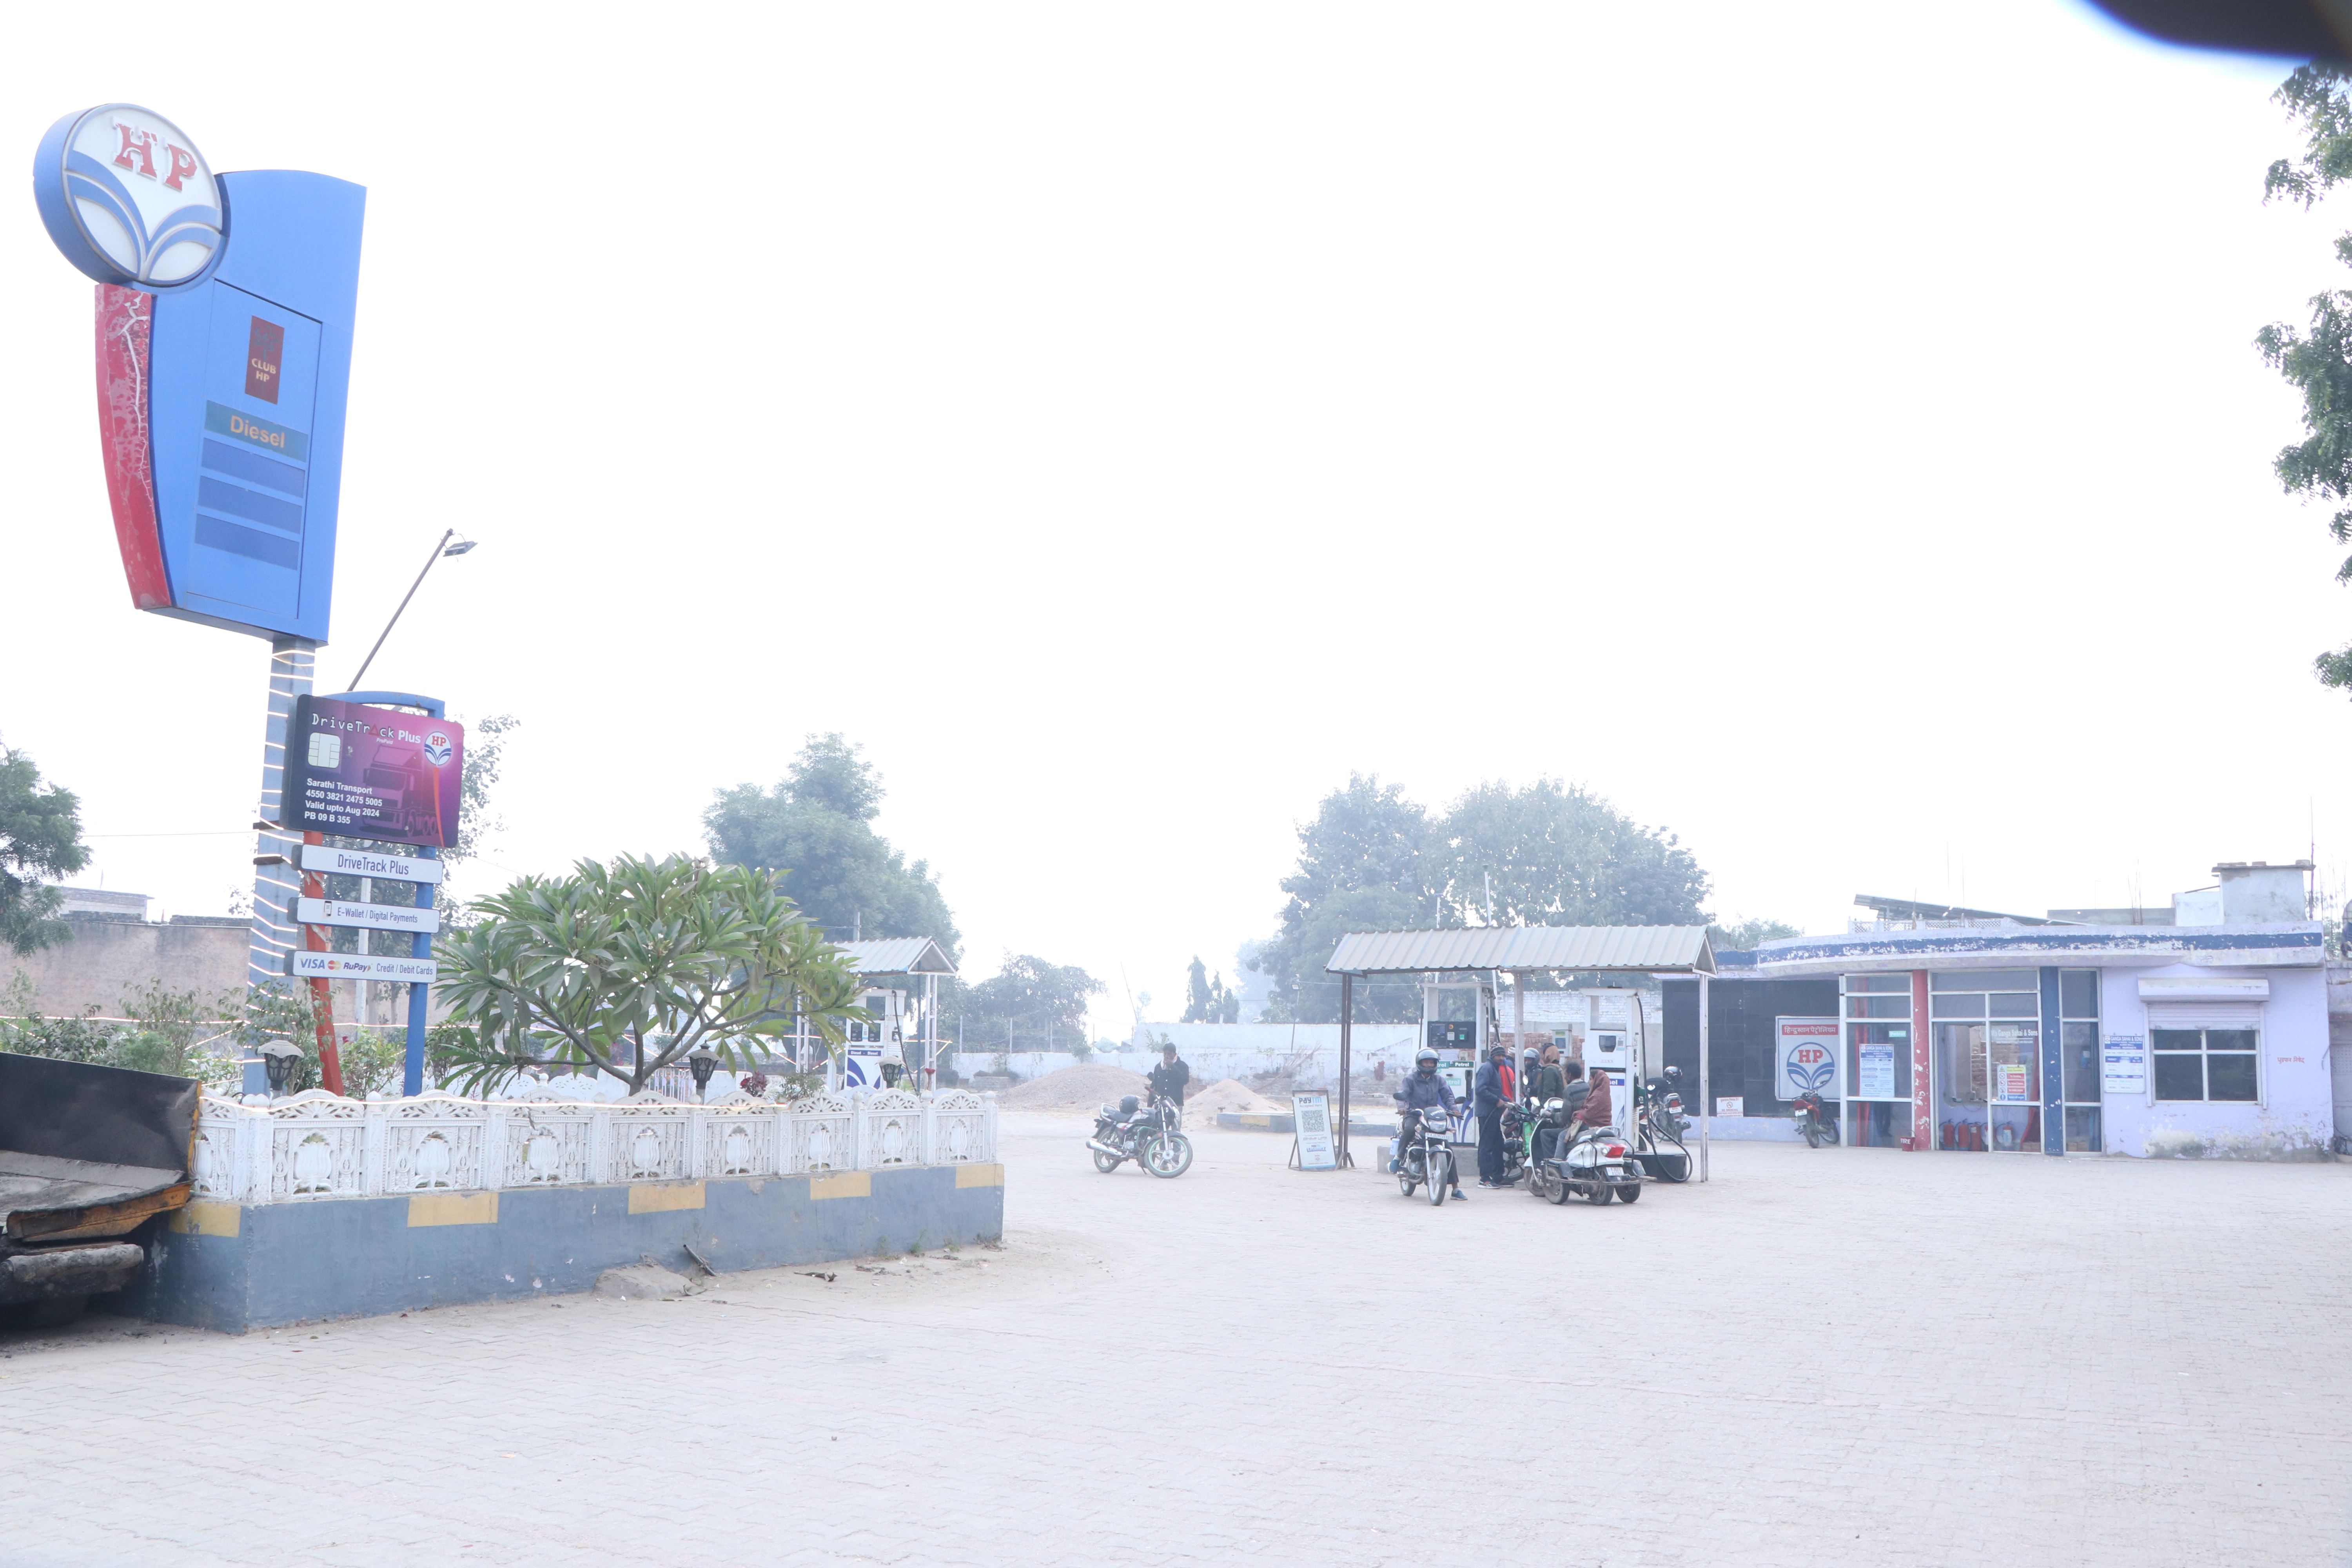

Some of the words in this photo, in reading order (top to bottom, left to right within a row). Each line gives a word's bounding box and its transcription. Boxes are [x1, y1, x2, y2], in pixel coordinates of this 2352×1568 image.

[112, 116, 198, 192] HP
[251, 358, 276, 374] CLUB
[256, 370, 270, 383] HP
[230, 416, 285, 448] Diesel
[398, 730, 421, 744] Plus
[432, 735, 446, 747] HP
[307, 778, 334, 789] Sarathi
[337, 782, 372, 795] Transport
[306, 789, 324, 799] 4550
[327, 792, 344, 801] 3821
[346, 795, 364, 804] 2475
[365, 797, 383, 807] 5005
[305, 800, 325, 810] Valid
[327, 804, 344, 815] upto
[345, 806, 360, 816] Aug
[362, 808, 380, 817] 2024
[305, 811, 316, 820] PB
[318, 813, 327, 822] 09
[337, 815, 350, 824] 355
[338, 854, 387, 873] DriveTrack
[390, 860, 409, 875] Plus
[338, 907, 364, 918] E-Wallet
[370, 910, 388, 921] Digital
[390, 913, 418, 924] Payments
[299, 958, 325, 970] VISA
[343, 962, 368, 973] RuPay
[376, 964, 394, 973] Credit
[399, 965, 415, 975] Debit
[416, 966, 433, 975] Cards
[1784, 1026, 1809, 1034] हिन्दुस्तान
[1810, 1026, 1836, 1034] पेट्रोलियम
[1798, 1049, 1824, 1063] HP
